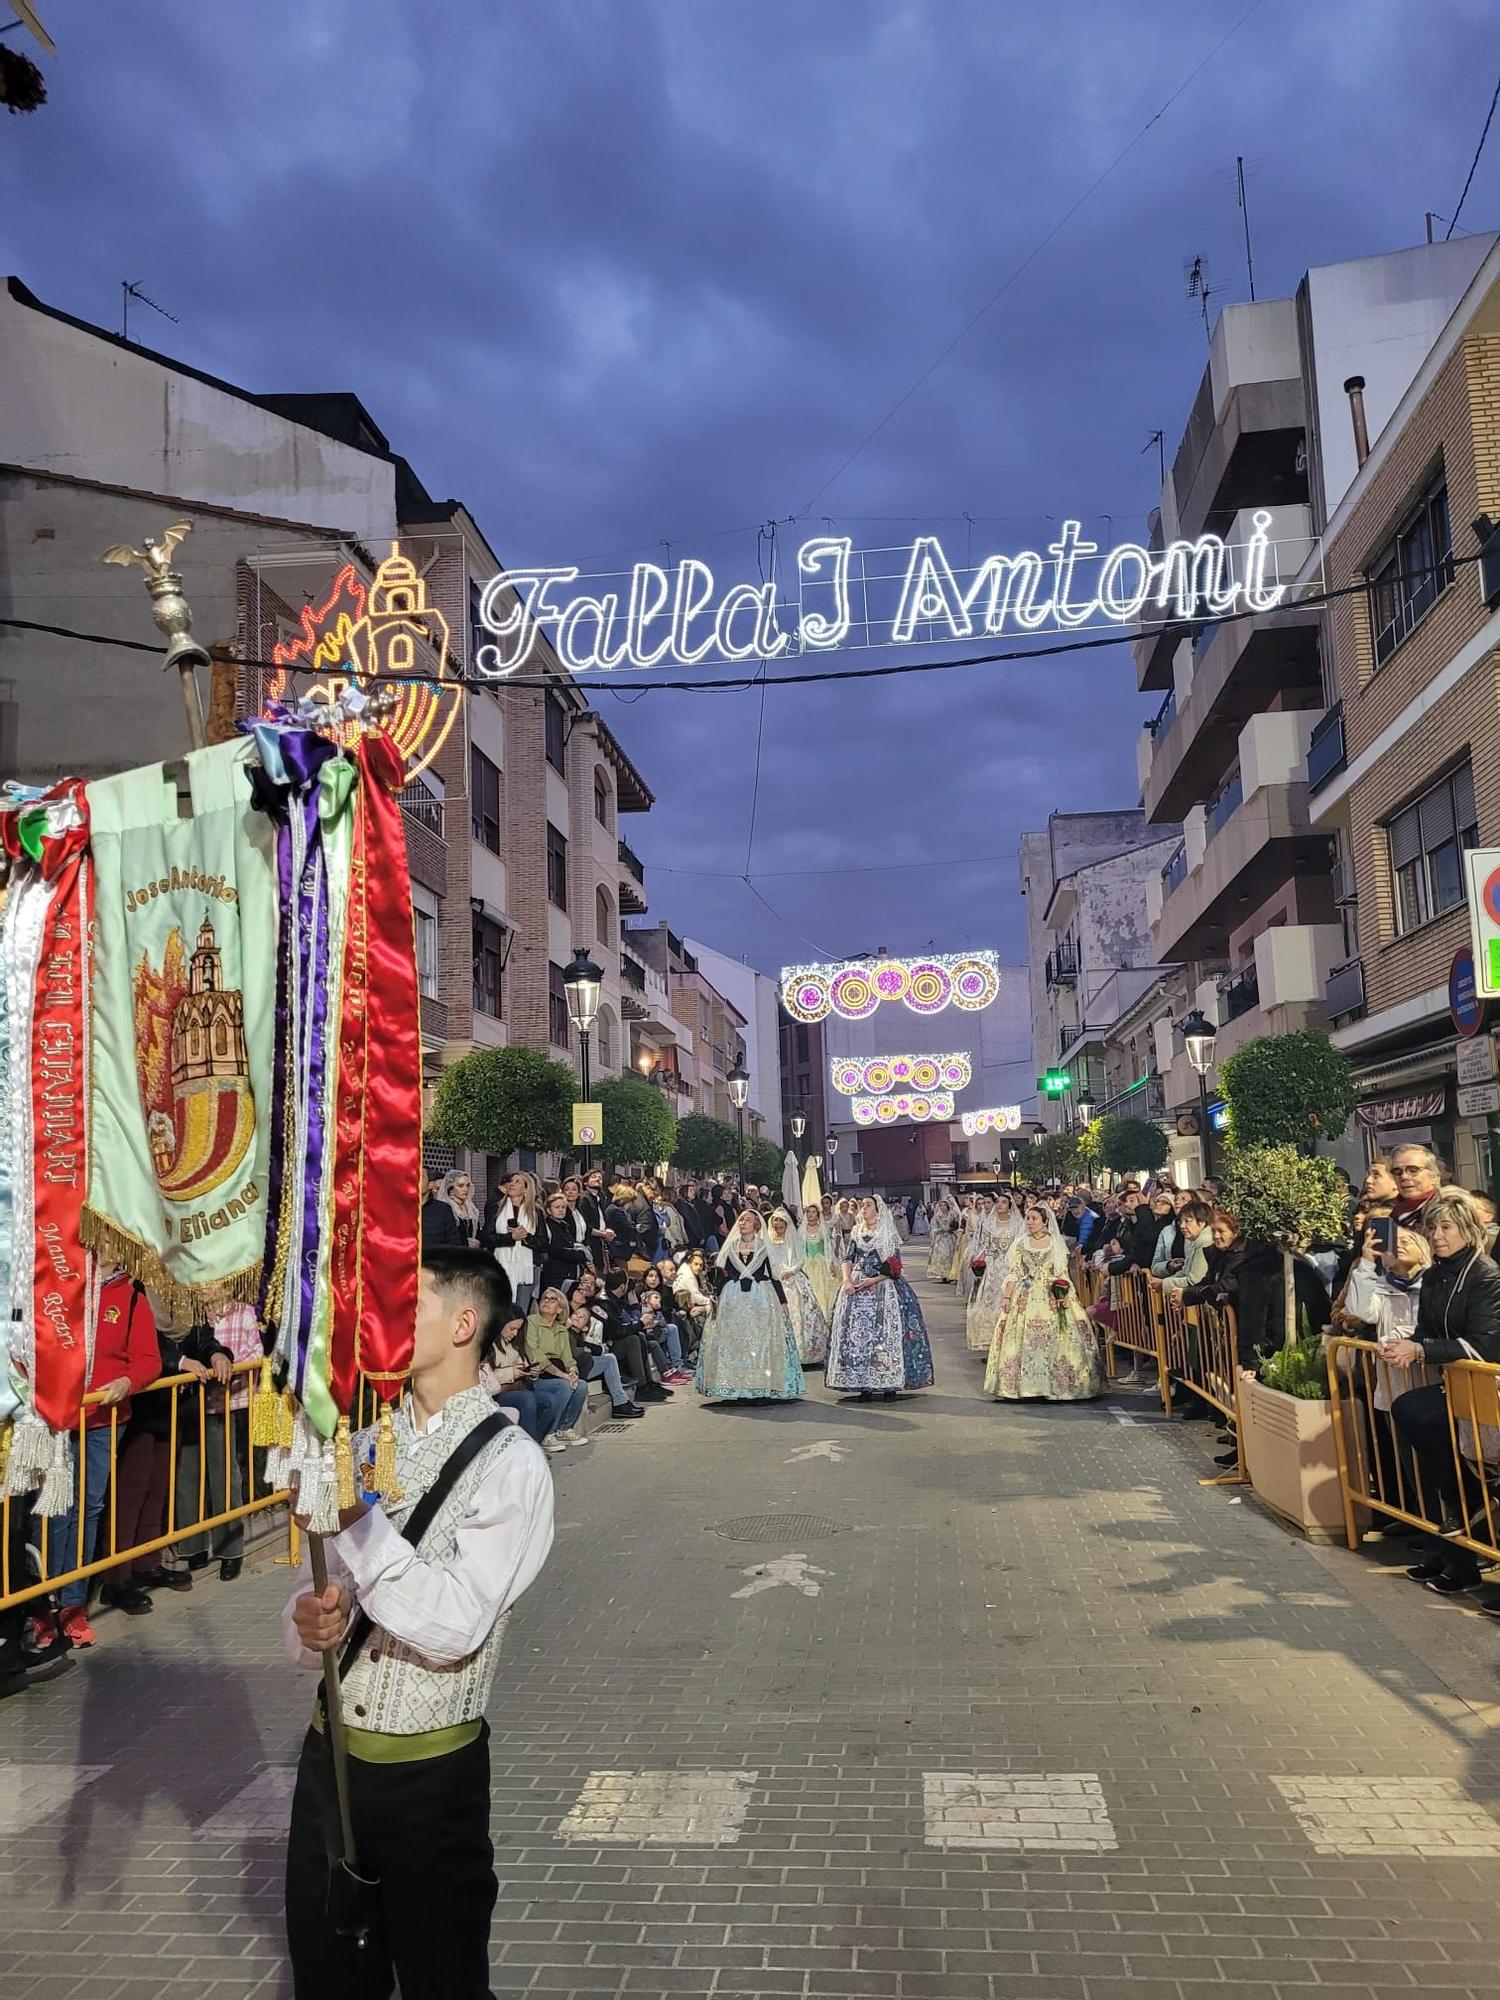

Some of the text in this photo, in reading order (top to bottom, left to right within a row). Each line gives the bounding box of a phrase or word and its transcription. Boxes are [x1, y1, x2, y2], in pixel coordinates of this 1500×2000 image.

[477, 511, 1285, 676] Falla J Antoni
[38, 1222, 80, 1349] Manel Ricart
